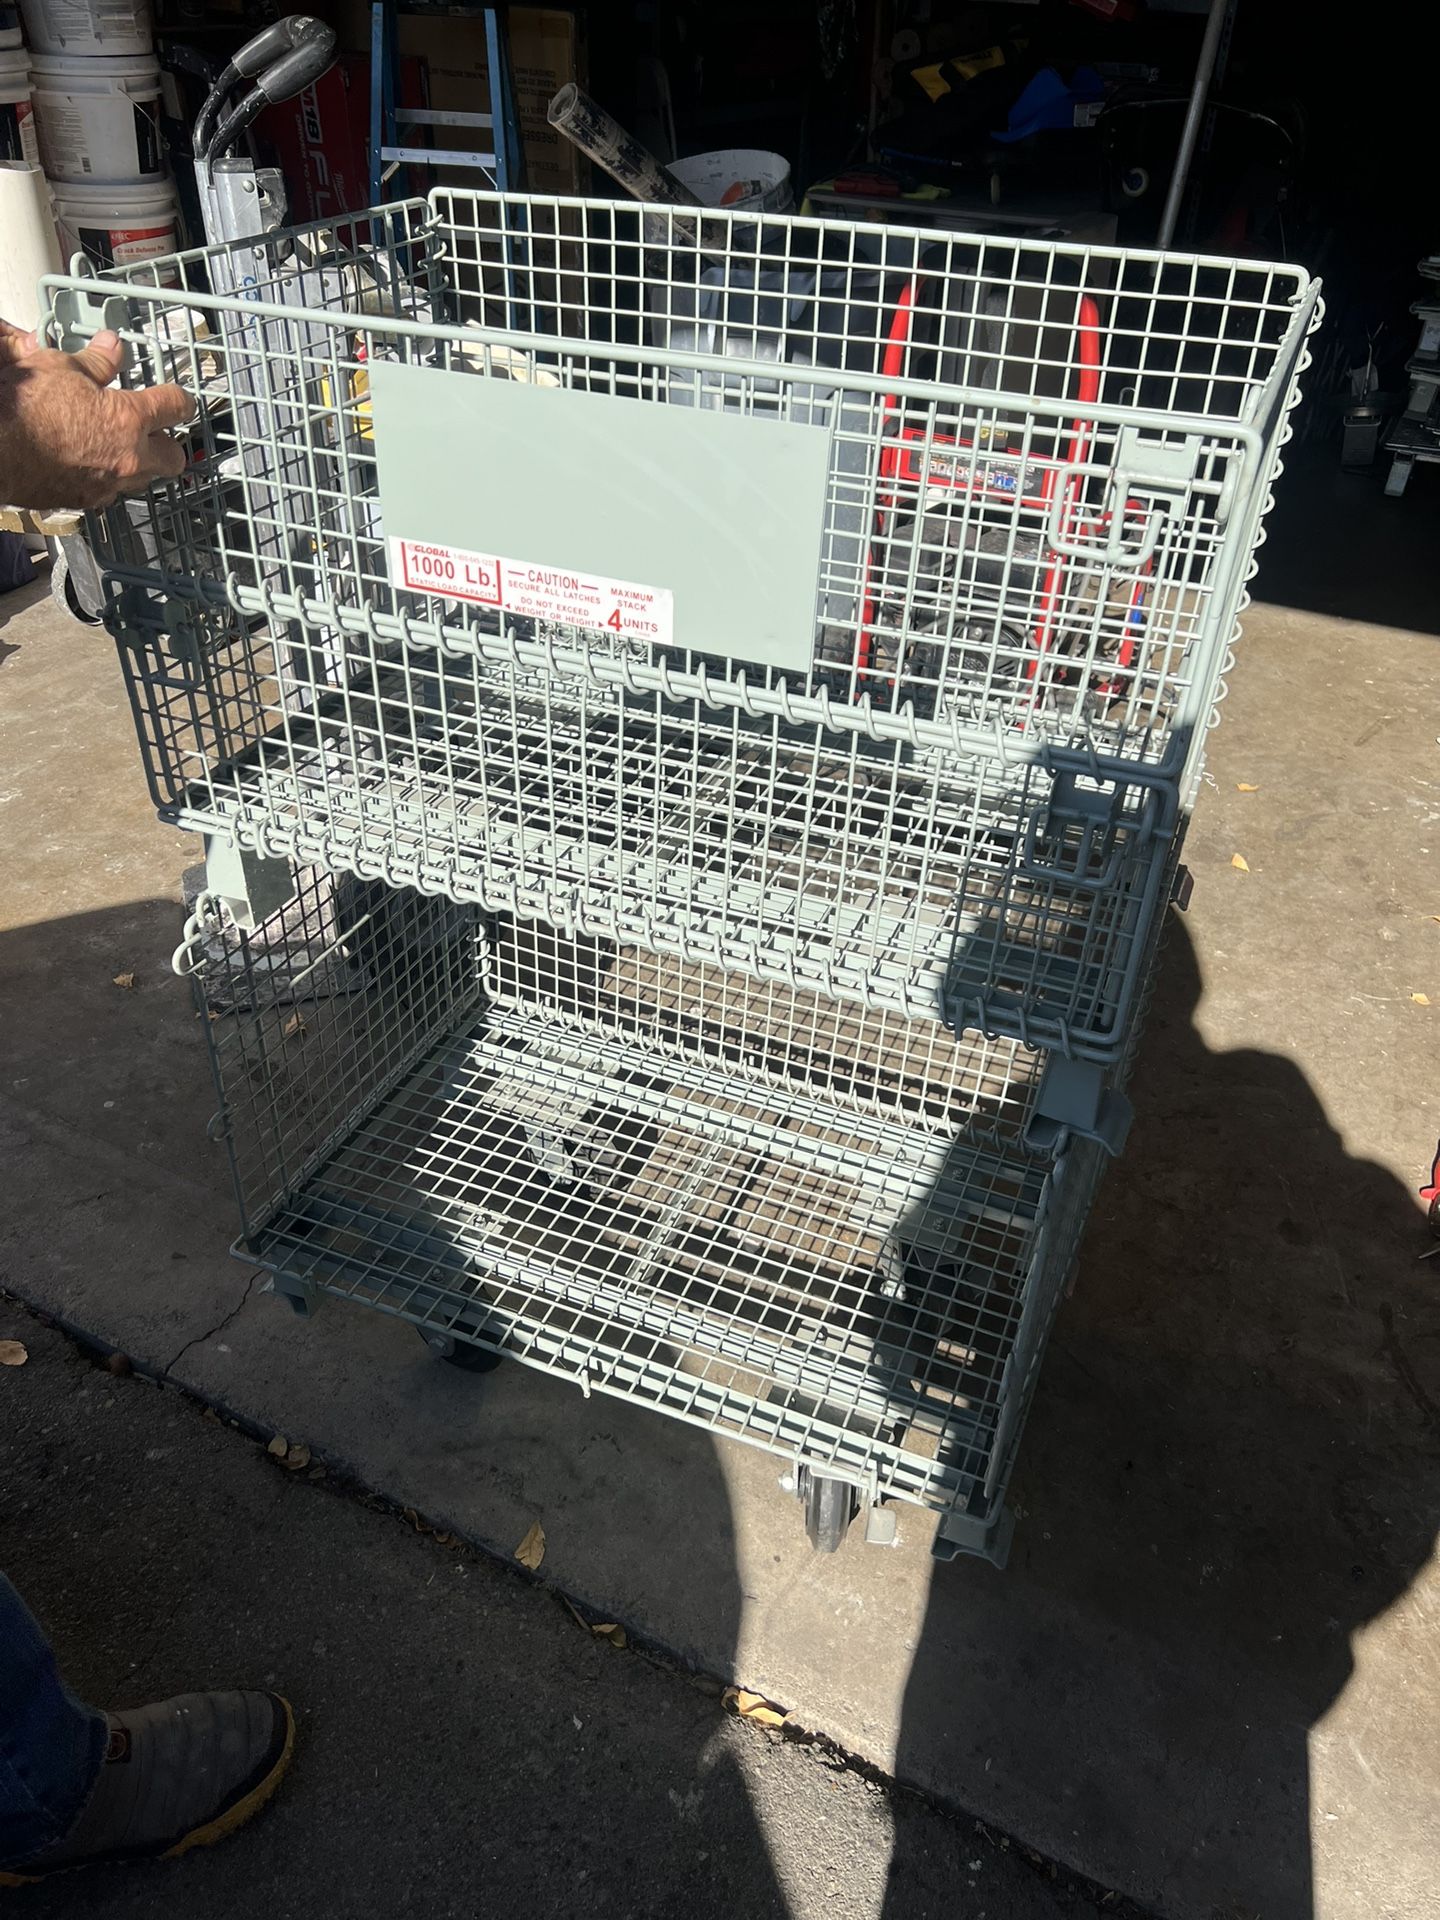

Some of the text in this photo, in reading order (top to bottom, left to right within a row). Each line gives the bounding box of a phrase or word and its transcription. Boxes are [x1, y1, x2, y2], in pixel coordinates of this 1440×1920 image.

[414, 545, 450, 558] GLOBAL
[411, 555, 455, 579] 1000
[465, 564, 496, 588] Lb.
[528, 569, 579, 590] CAUTION
[410, 577, 496, 598] STATIC LOAD CAPACITY
[508, 580, 601, 604] SECURE ALL LATCHES
[611, 588, 653, 602] MAXIMUM
[514, 605, 595, 627] WEIGHT OR HEIGHT
[520, 596, 589, 616] DO NOT EXCEED
[617, 599, 647, 612] STACK
[607, 608, 658, 633] 4 UNITS
